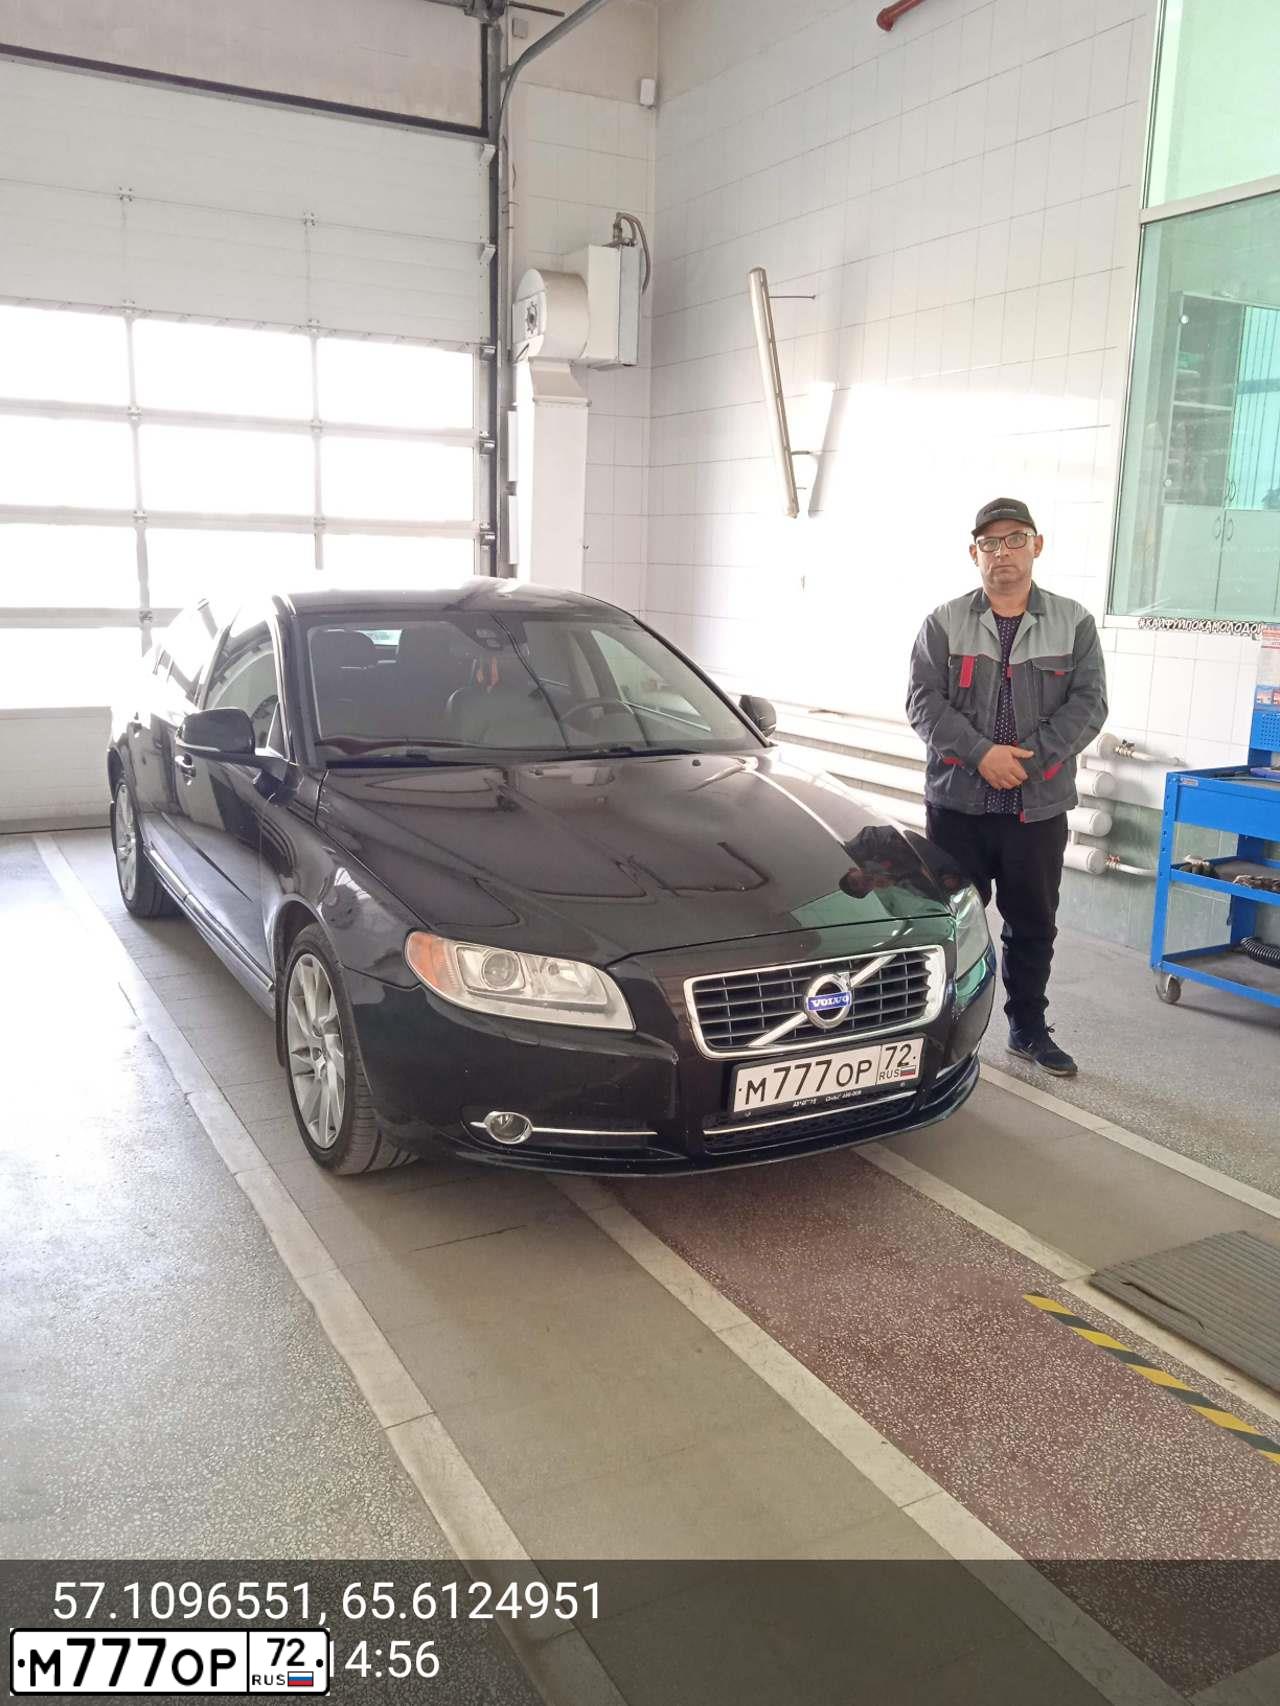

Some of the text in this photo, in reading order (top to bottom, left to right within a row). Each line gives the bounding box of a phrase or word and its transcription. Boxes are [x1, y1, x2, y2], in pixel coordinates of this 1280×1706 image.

[810, 994, 850, 1008] VOLVO
[885, 1044, 912, 1070] 72
[879, 1069, 899, 1080] RUS
